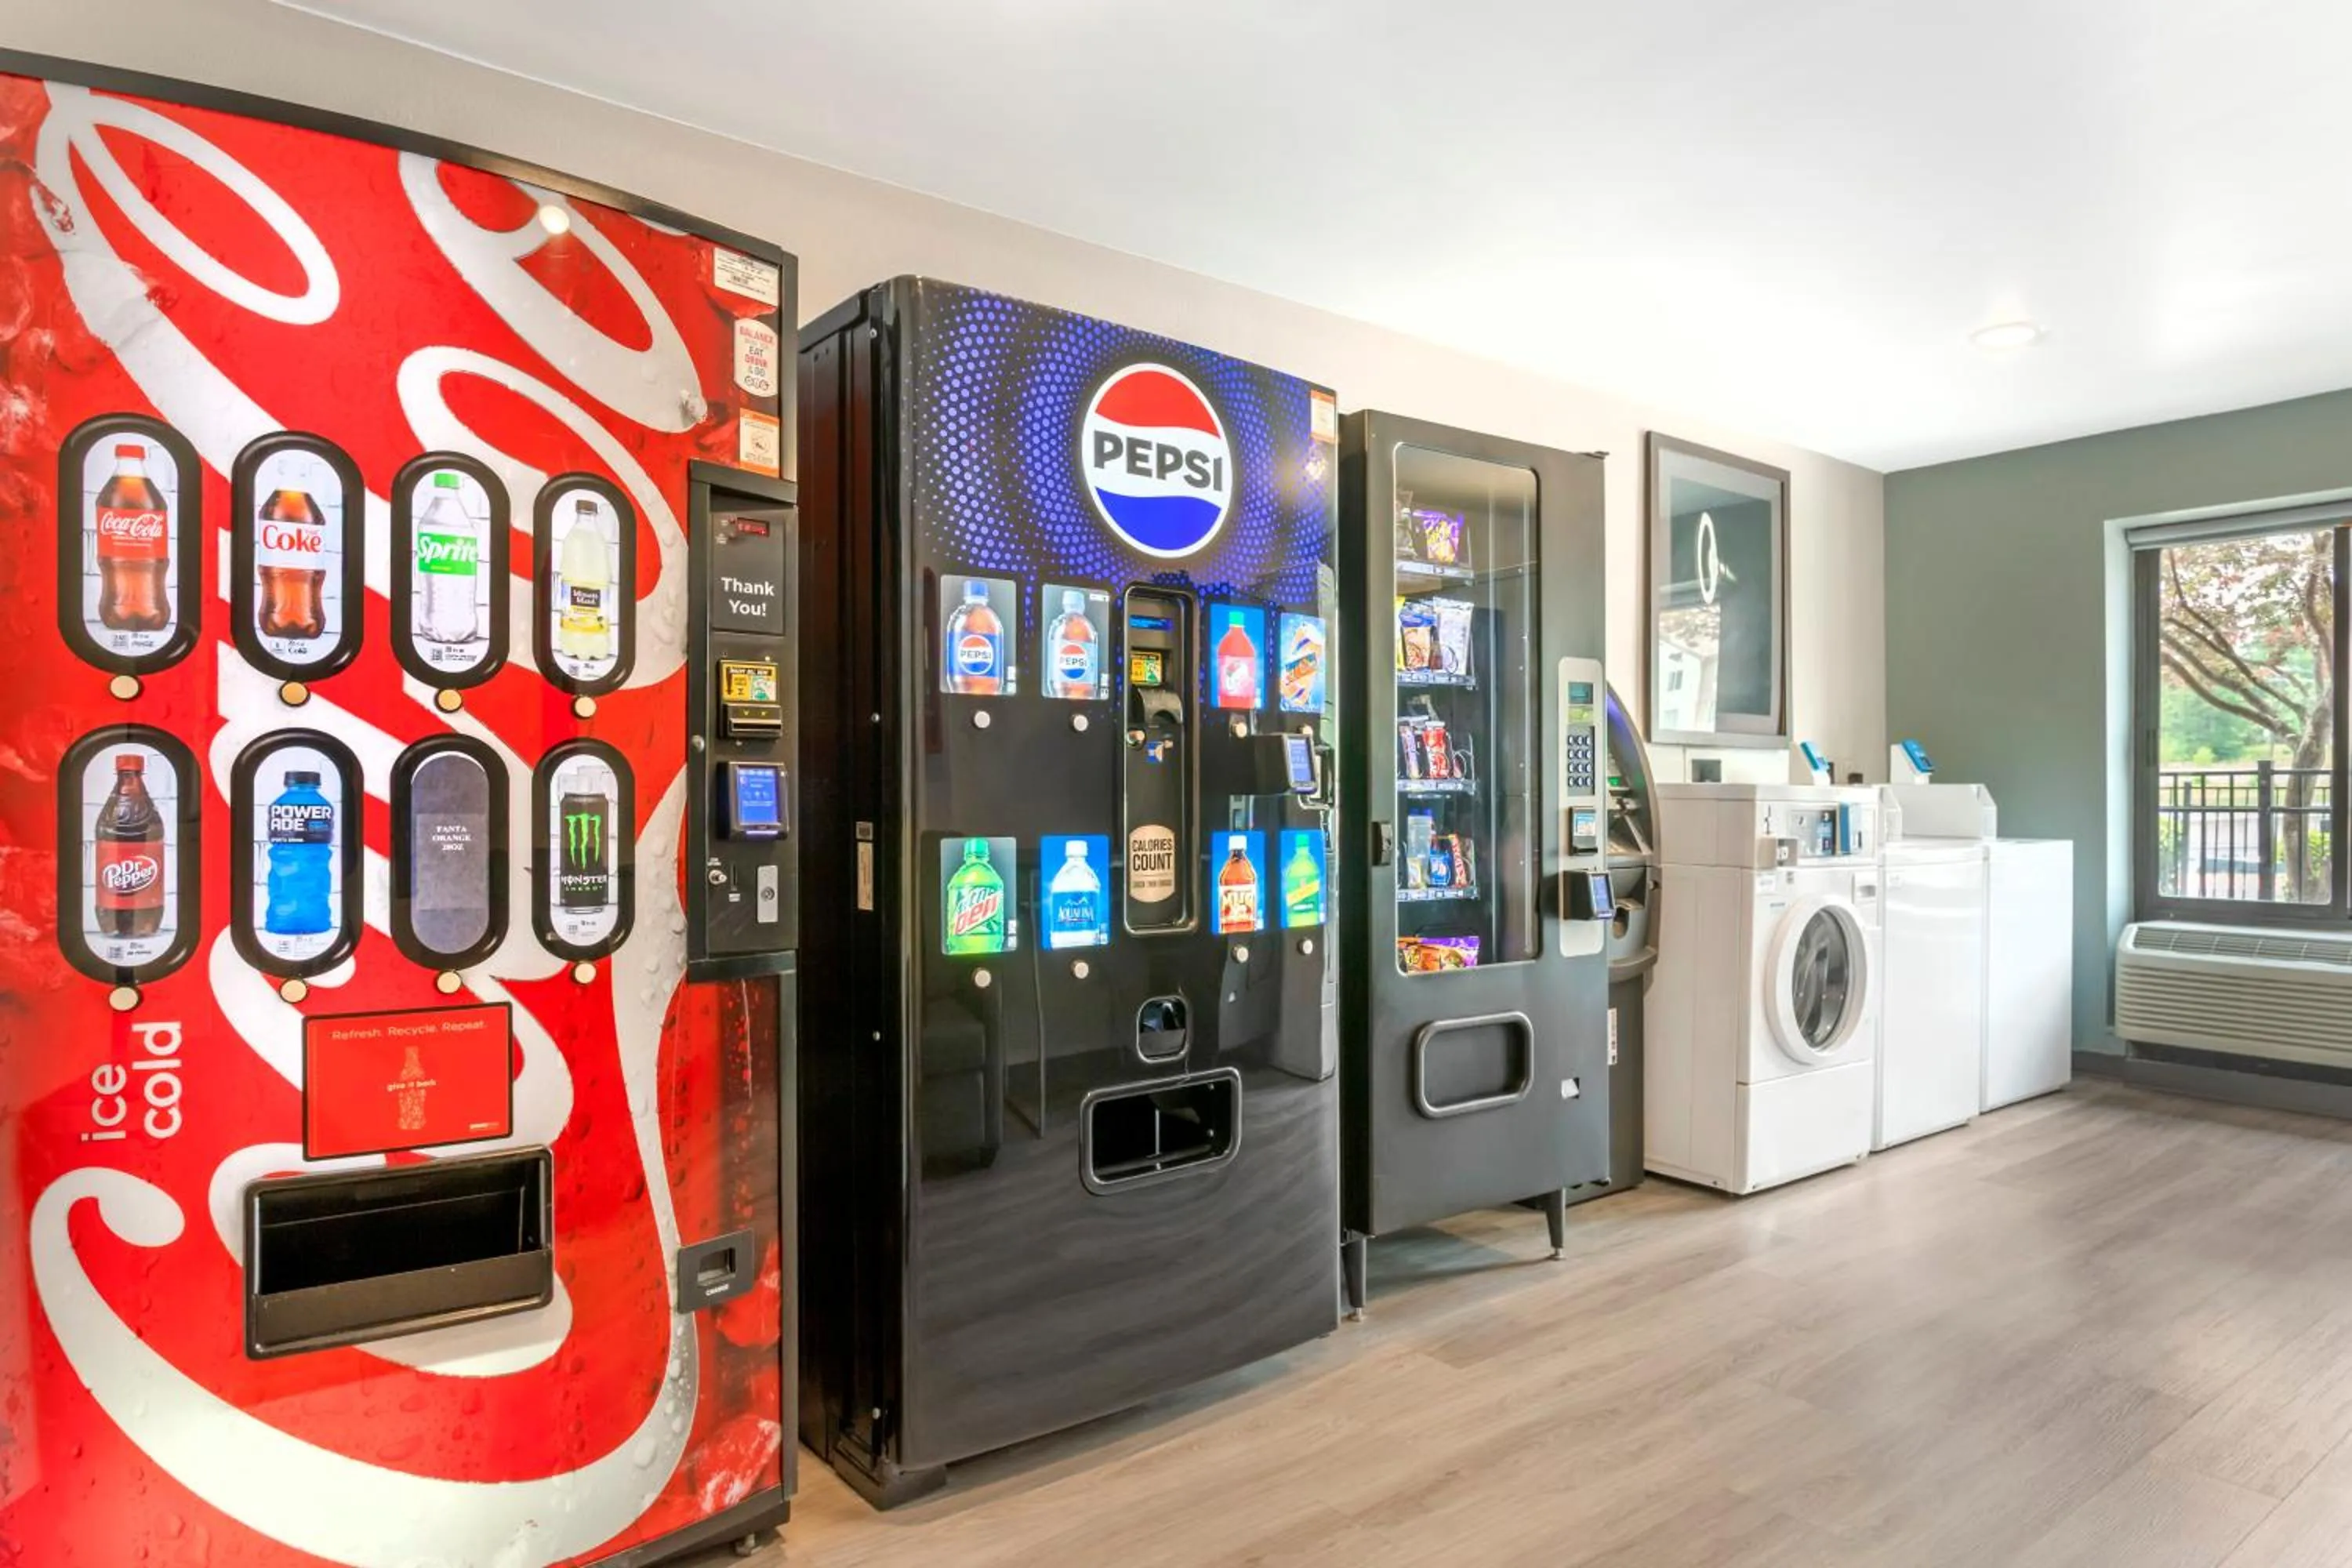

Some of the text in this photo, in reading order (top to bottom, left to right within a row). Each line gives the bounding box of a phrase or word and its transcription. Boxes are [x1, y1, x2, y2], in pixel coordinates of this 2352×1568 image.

[749, 346, 764, 358] EAT
[1093, 430, 1223, 492] PEPSI
[100, 511, 163, 538] Coca-Cola
[263, 524, 321, 553] Coke
[720, 576, 775, 597] Thank
[728, 599, 767, 617] You!
[960, 650, 991, 659] PEPSI
[271, 805, 332, 819] POWER
[270, 818, 305, 832] ADE
[1132, 839, 1173, 852] CALORIES
[121, 860, 143, 875] Dr
[1132, 853, 1173, 872] COUNT
[103, 863, 153, 888] Pepper
[132, 1021, 183, 1139] cold
[80, 1063, 127, 1142] ice
